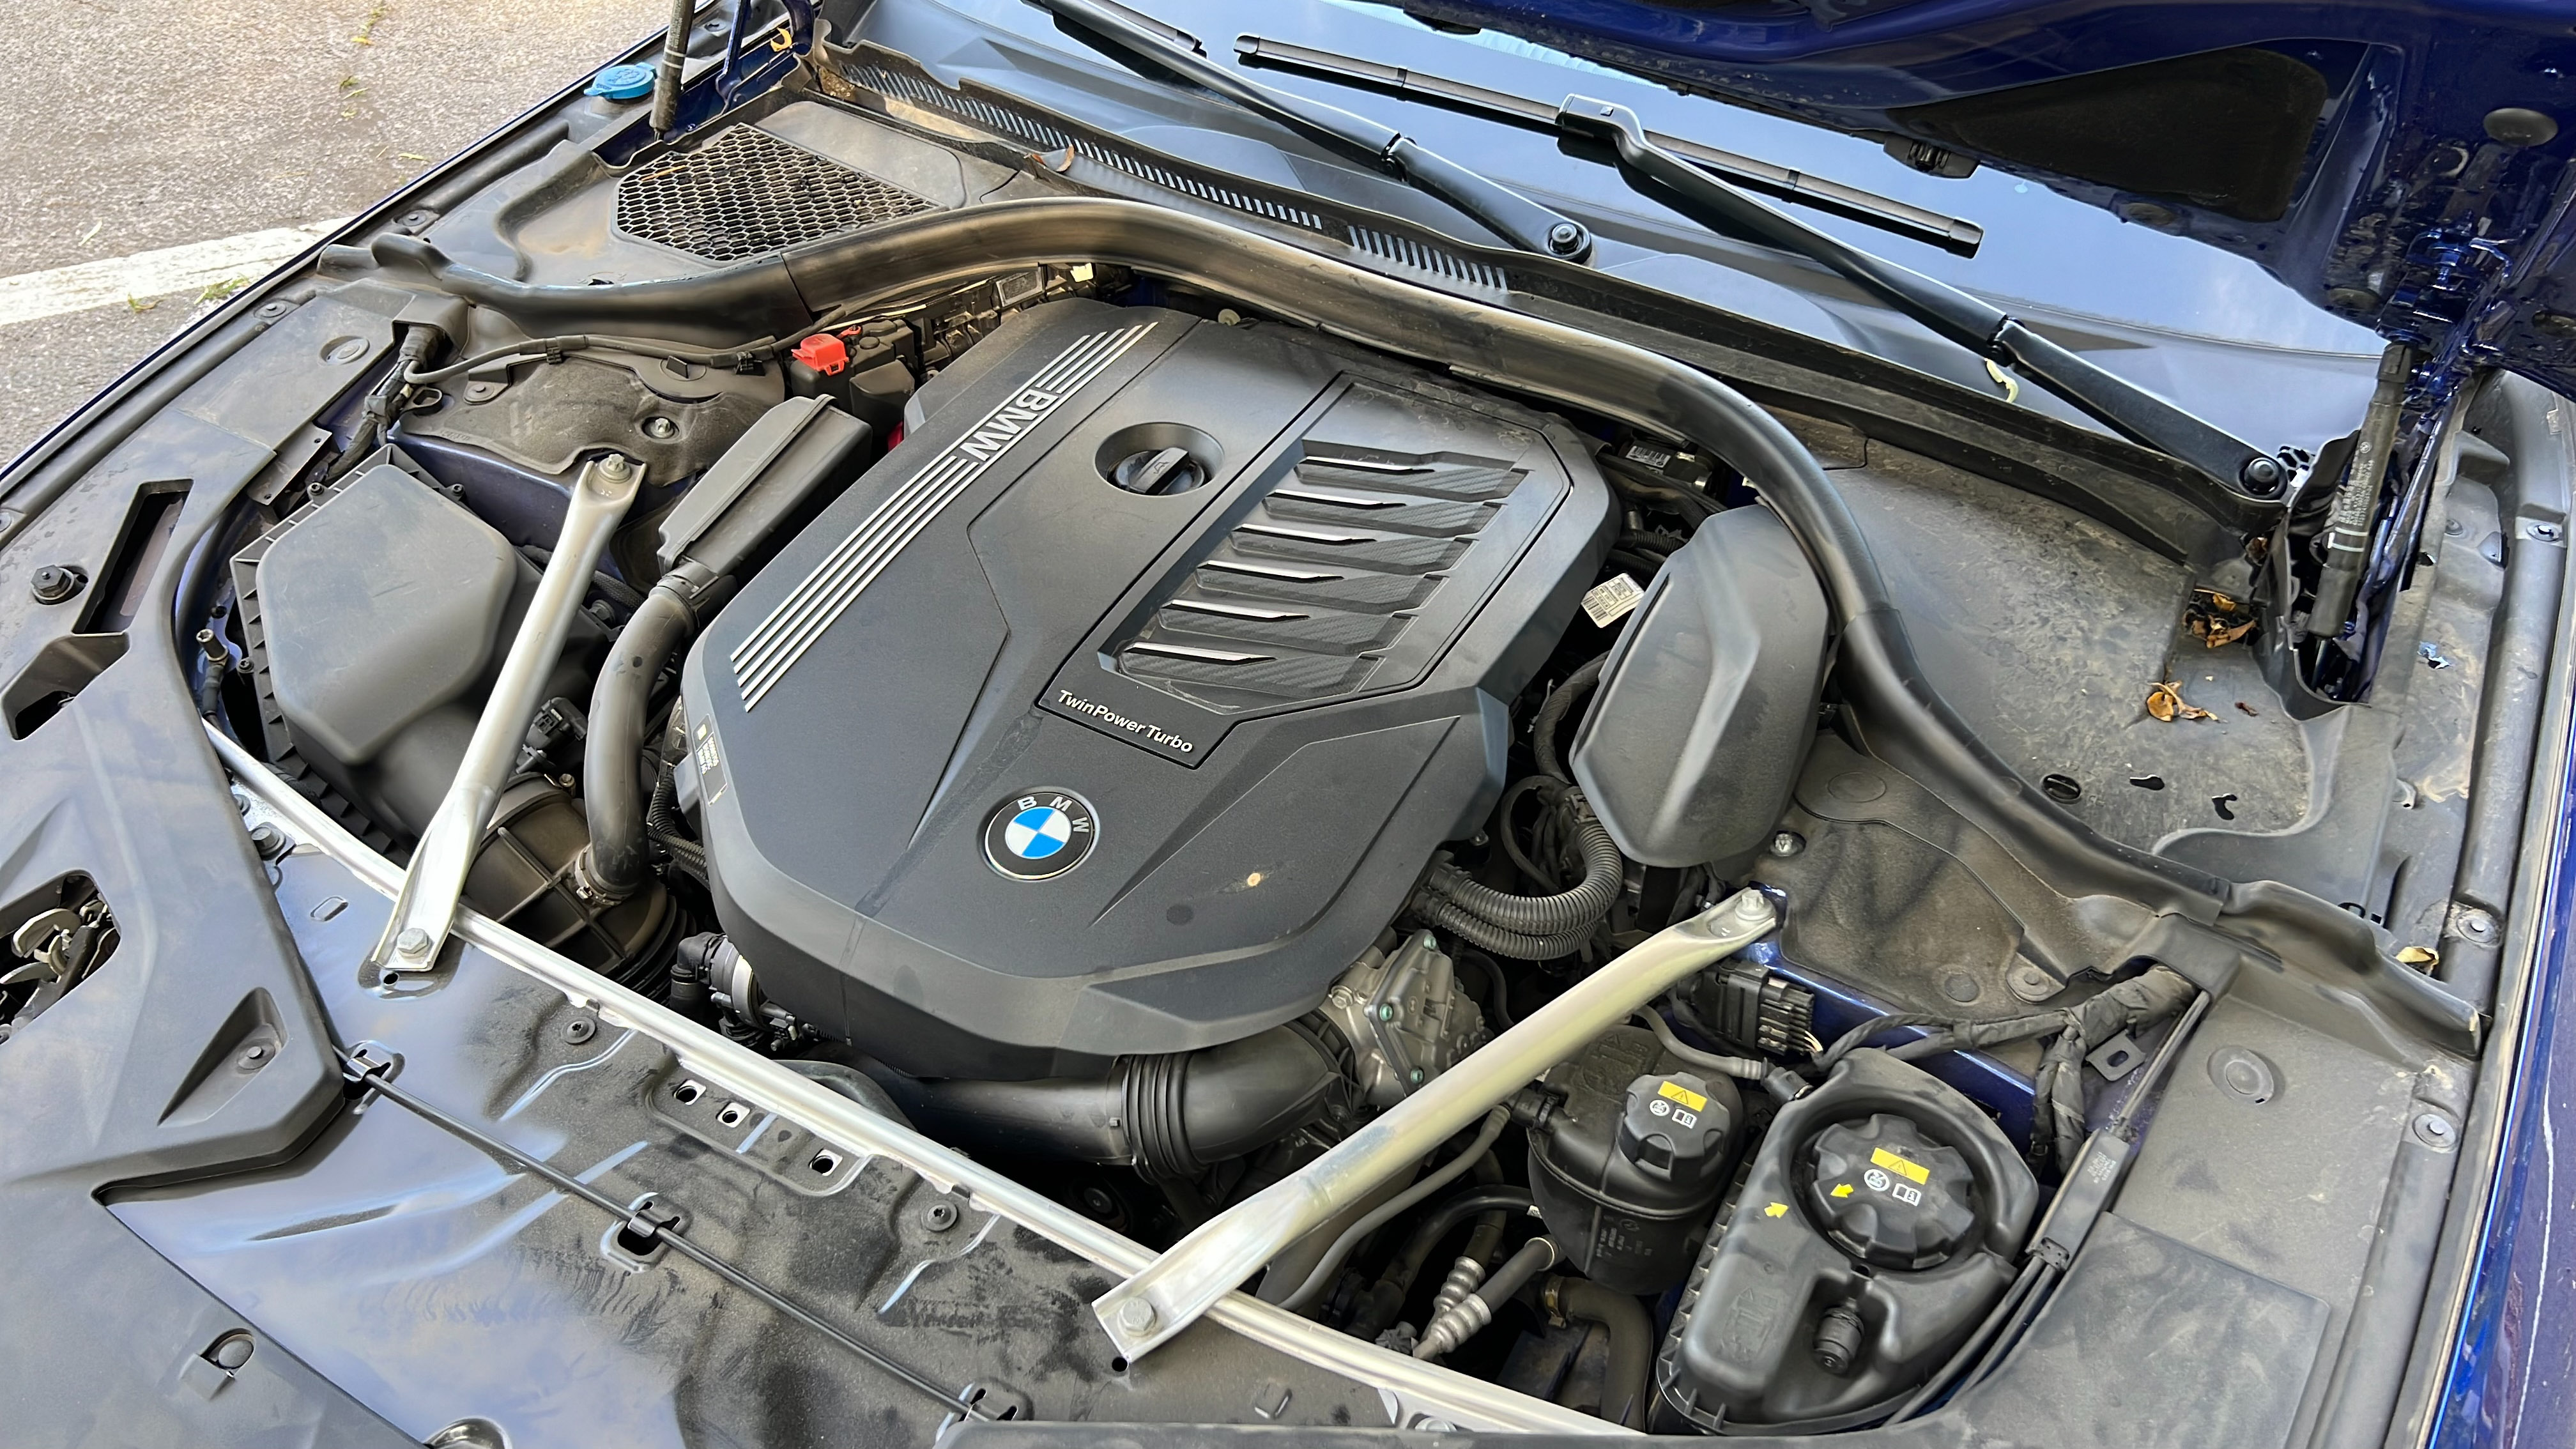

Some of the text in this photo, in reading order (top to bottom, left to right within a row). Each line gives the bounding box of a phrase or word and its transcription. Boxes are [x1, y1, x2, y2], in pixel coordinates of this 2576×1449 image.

[960, 388, 1059, 461] BMW
[1058, 689, 1193, 753] TwinPower Turbo
[1017, 795, 1089, 832] BMW
